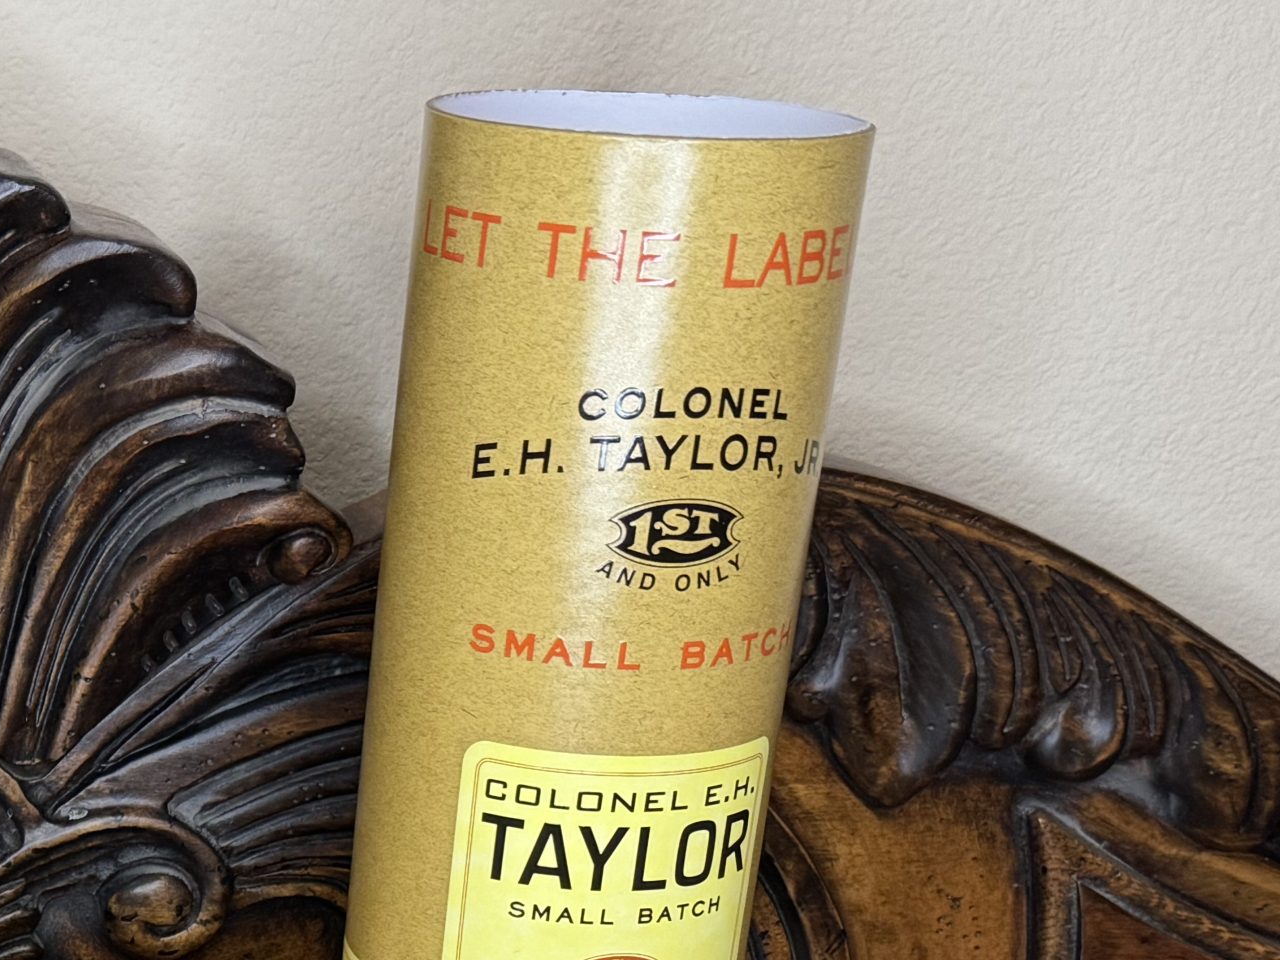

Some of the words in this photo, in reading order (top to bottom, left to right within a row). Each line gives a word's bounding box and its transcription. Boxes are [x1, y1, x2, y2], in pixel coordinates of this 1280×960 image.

[423, 198, 502, 268] LET
[537, 222, 682, 288] THE
[723, 222, 854, 289] LABE
[577, 387, 789, 422] COLONEL
[471, 437, 565, 479] E.H.
[589, 433, 783, 479] TAYLOR,
[627, 508, 720, 557] 1ST
[596, 558, 656, 592] AND
[675, 553, 743, 593] ONLY
[469, 622, 641, 671] SMALL
[681, 618, 792, 670] BATCH
[484, 778, 689, 813] COLONEL
[704, 776, 756, 808] E.H.
[481, 808, 751, 892] TAYLOR
[508, 900, 614, 926] SMALL
[637, 895, 721, 925] BATCH
